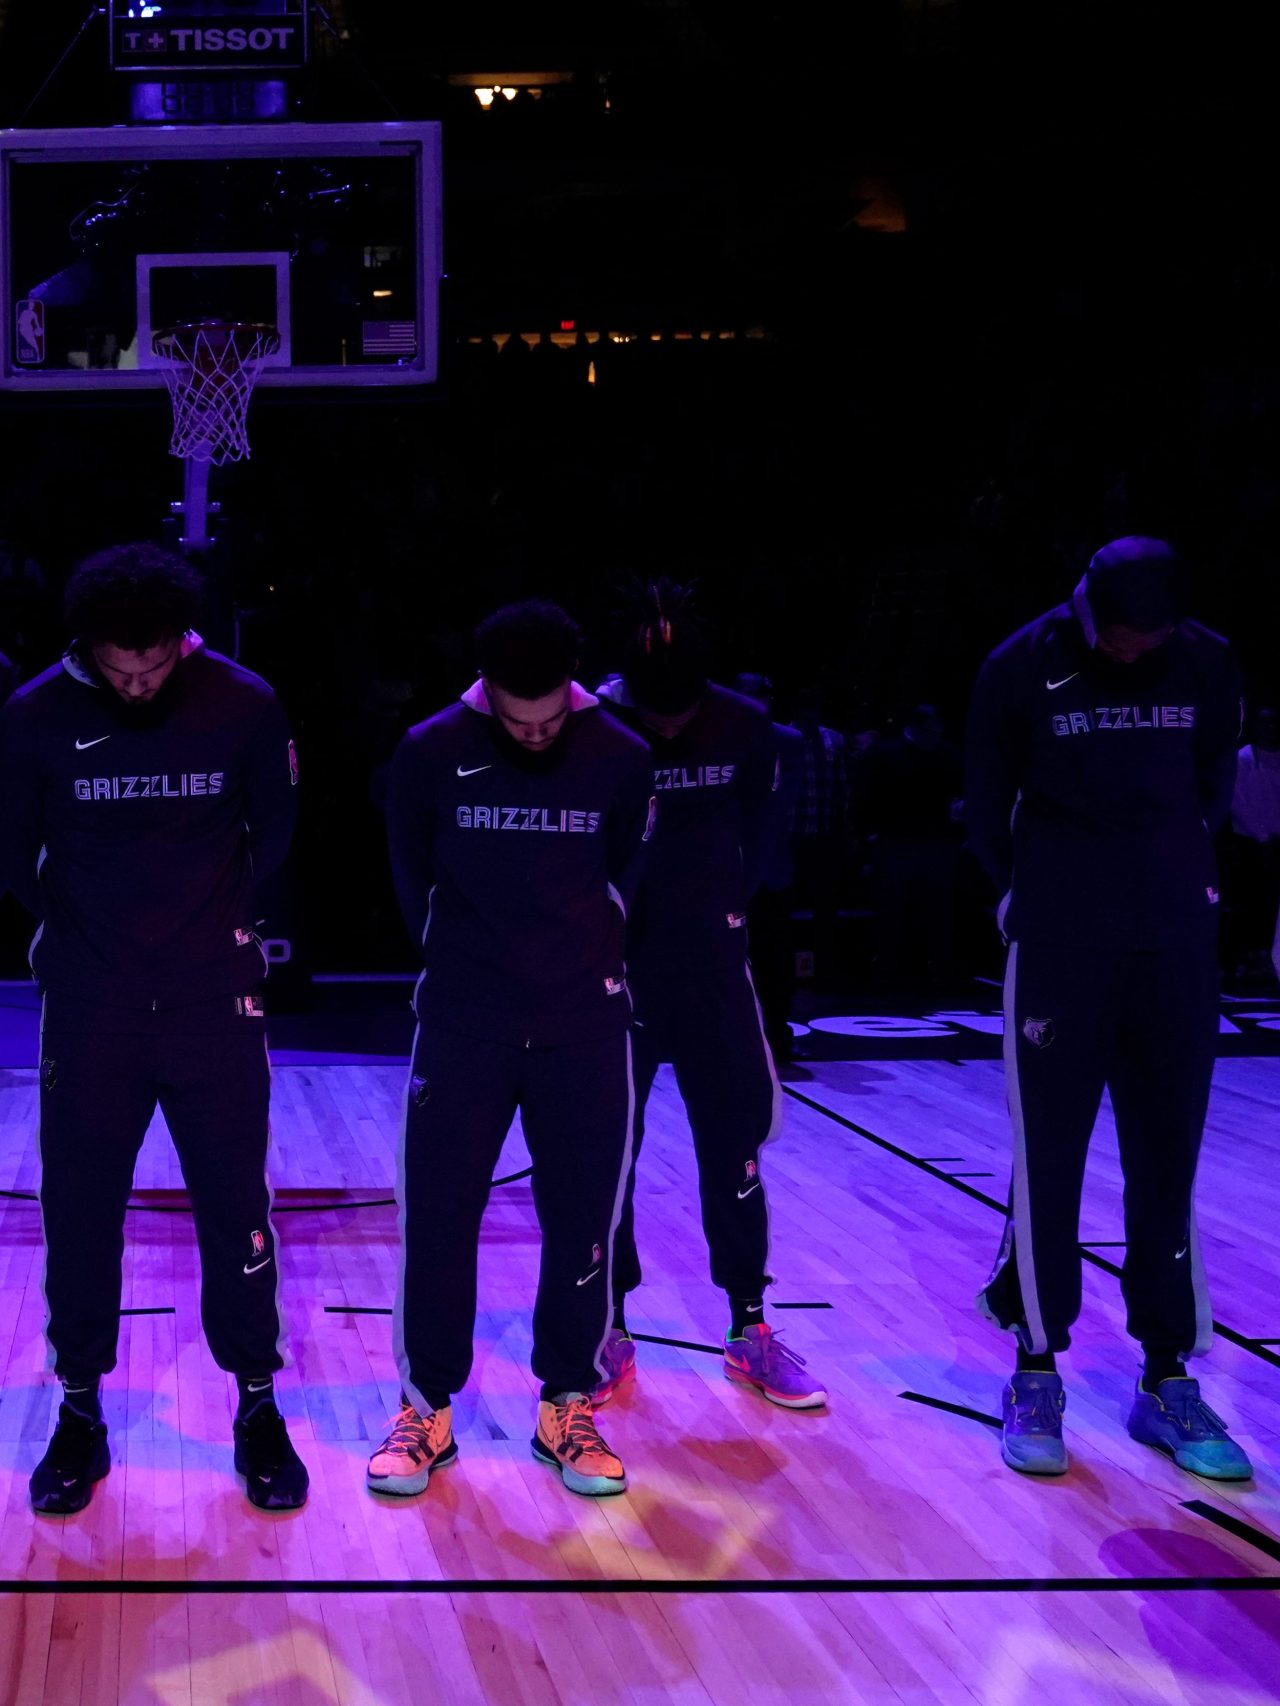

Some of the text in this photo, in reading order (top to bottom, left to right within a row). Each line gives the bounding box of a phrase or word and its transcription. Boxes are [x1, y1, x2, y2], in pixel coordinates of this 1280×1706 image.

[169, 27, 295, 52] TISSOT
[74, 771, 224, 801] GRIZZLIES
[653, 764, 735, 791] ZZLIES
[456, 805, 601, 834] GRIZZLIES
